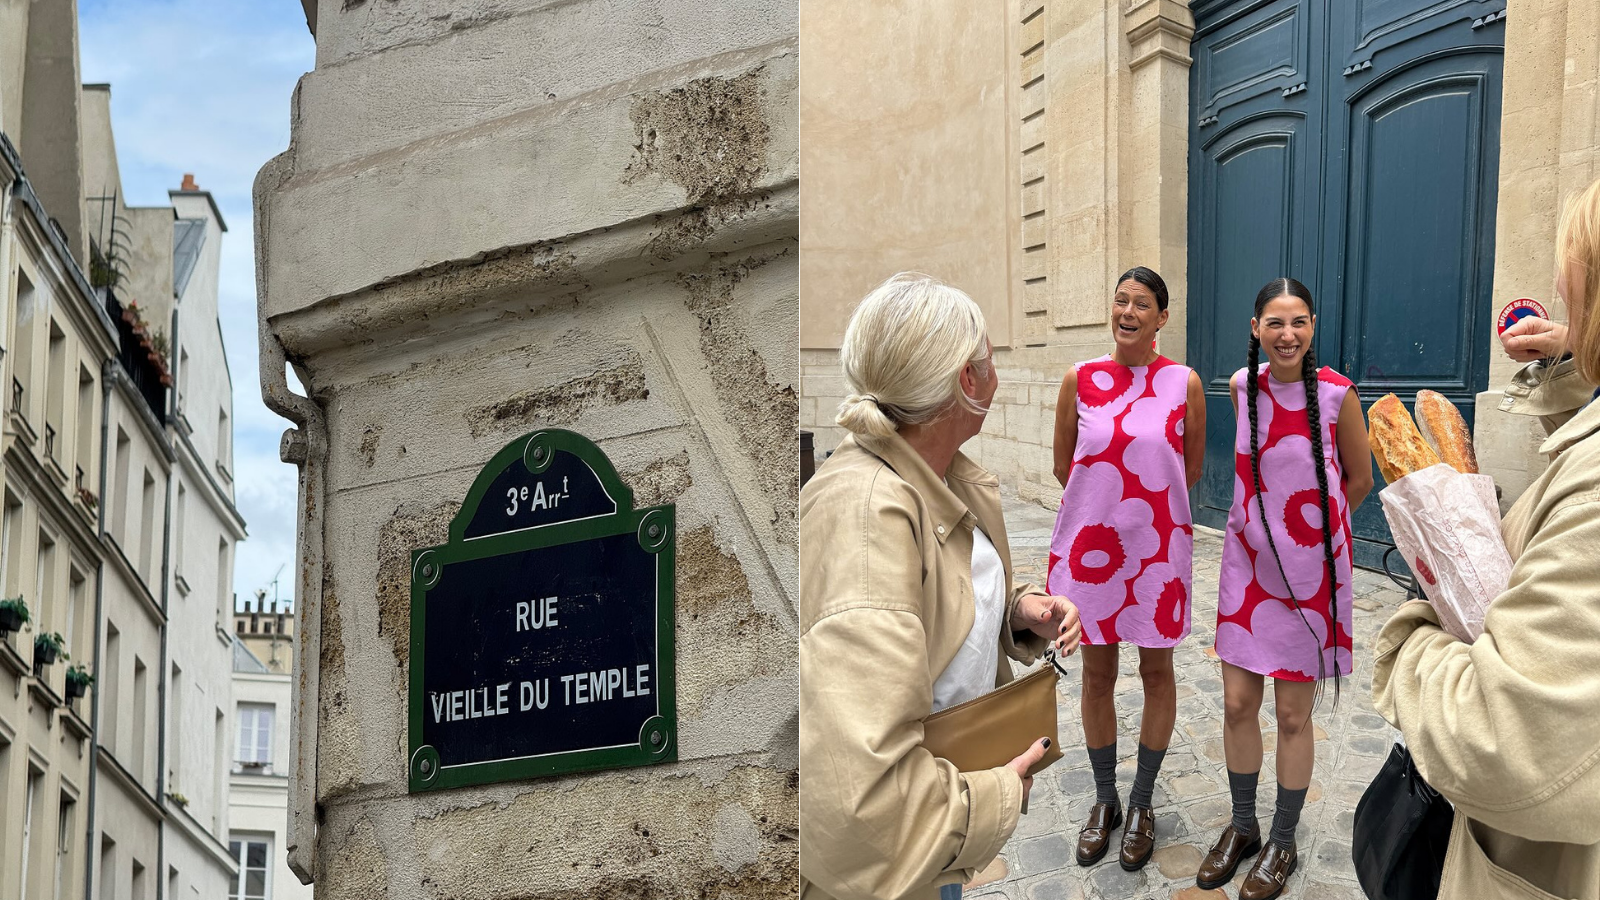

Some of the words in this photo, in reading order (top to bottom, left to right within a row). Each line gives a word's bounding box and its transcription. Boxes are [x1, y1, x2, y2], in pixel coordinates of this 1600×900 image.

[1499, 305, 1514, 326] DÉFENSE
[1514, 300, 1522, 308] DE
[1522, 300, 1546, 320] STATIONNE
[516, 596, 558, 632] RUE
[431, 684, 509, 723] VIEILLE
[520, 678, 549, 712] DU
[561, 664, 650, 705] TEMPLE
